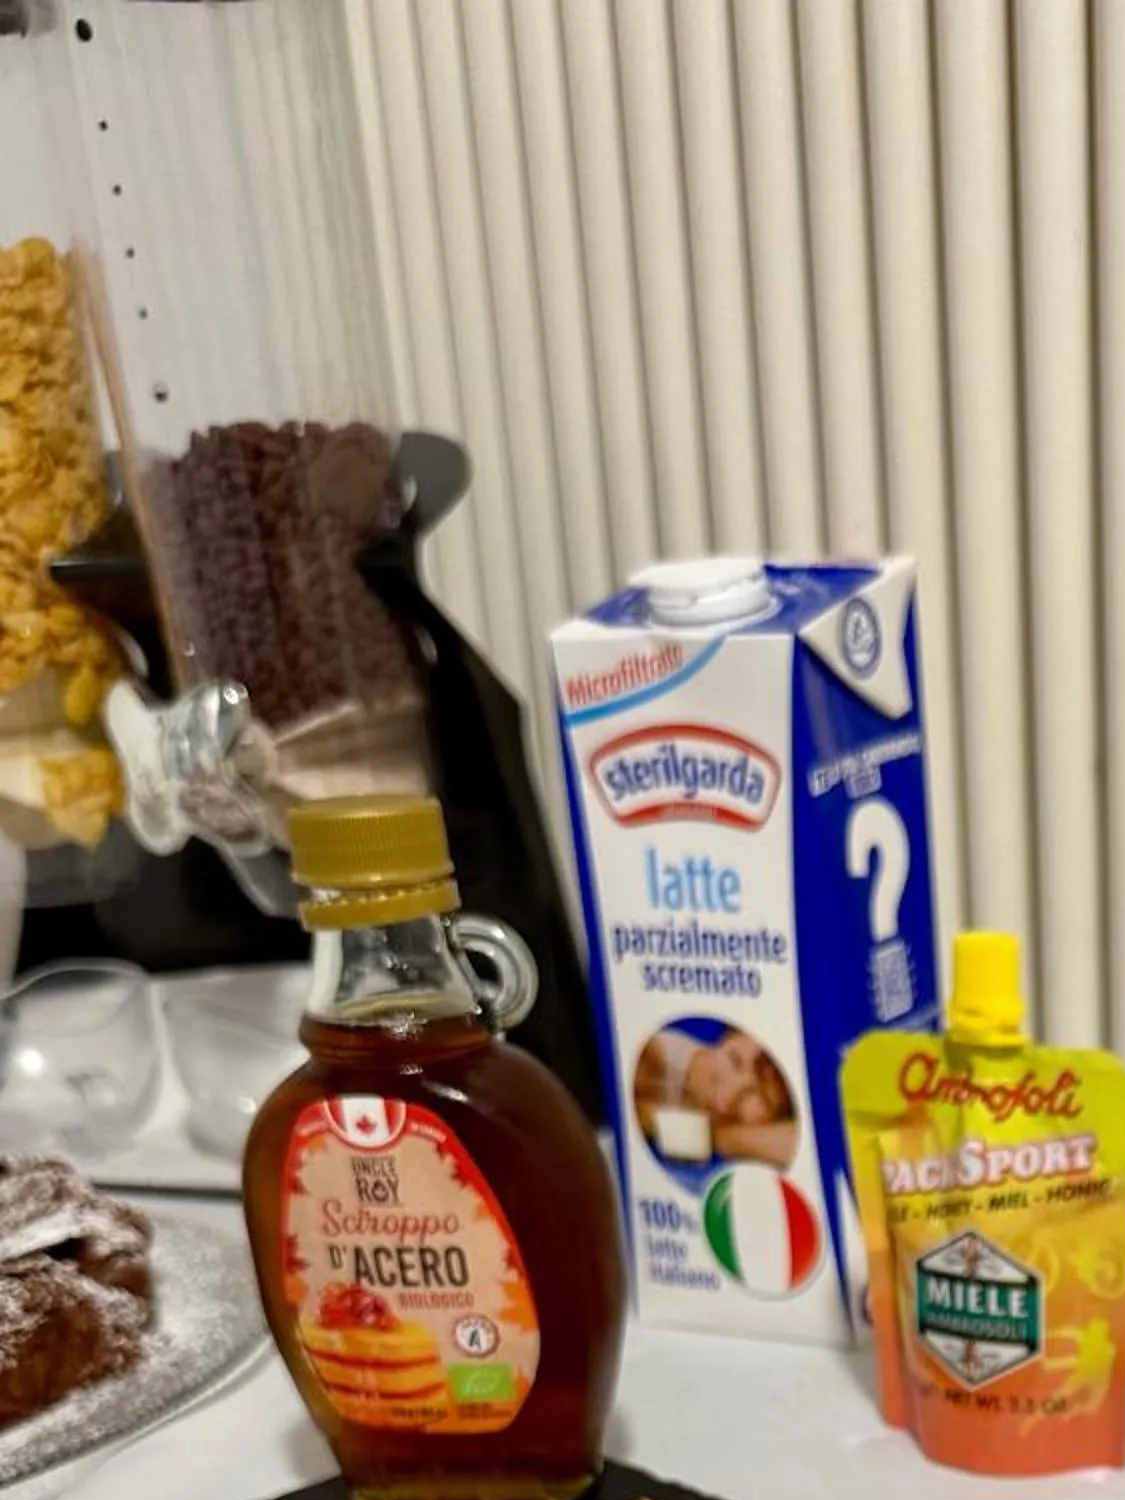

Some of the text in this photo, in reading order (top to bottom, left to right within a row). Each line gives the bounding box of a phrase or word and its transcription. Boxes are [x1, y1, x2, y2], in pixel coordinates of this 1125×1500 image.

[606, 743, 765, 804] sterilgarda
[644, 846, 741, 913] latte
[614, 921, 788, 964] parzialmente
[641, 962, 762, 998] scremato
[351, 1157, 397, 1177] UNCLE
[356, 1178, 399, 1203] ROY
[322, 1199, 460, 1243] Sciroppo
[926, 1276, 1029, 1318] MIELE
